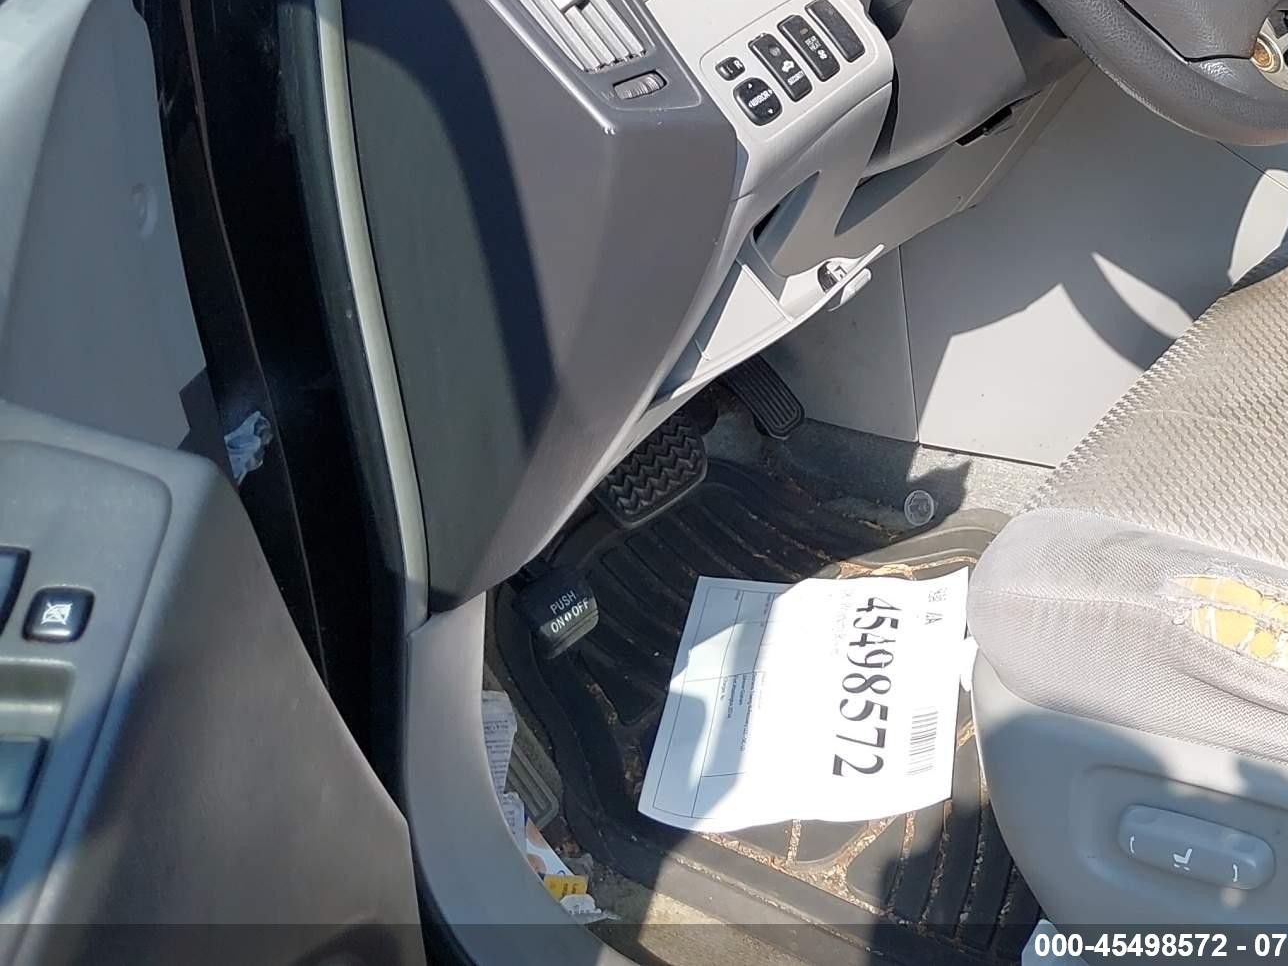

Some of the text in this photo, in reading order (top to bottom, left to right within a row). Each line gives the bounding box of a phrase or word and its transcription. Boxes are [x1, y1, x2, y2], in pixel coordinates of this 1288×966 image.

[549, 589, 577, 615] PUSH
[550, 597, 590, 634] ON OFF
[832, 597, 902, 776] 45498572
